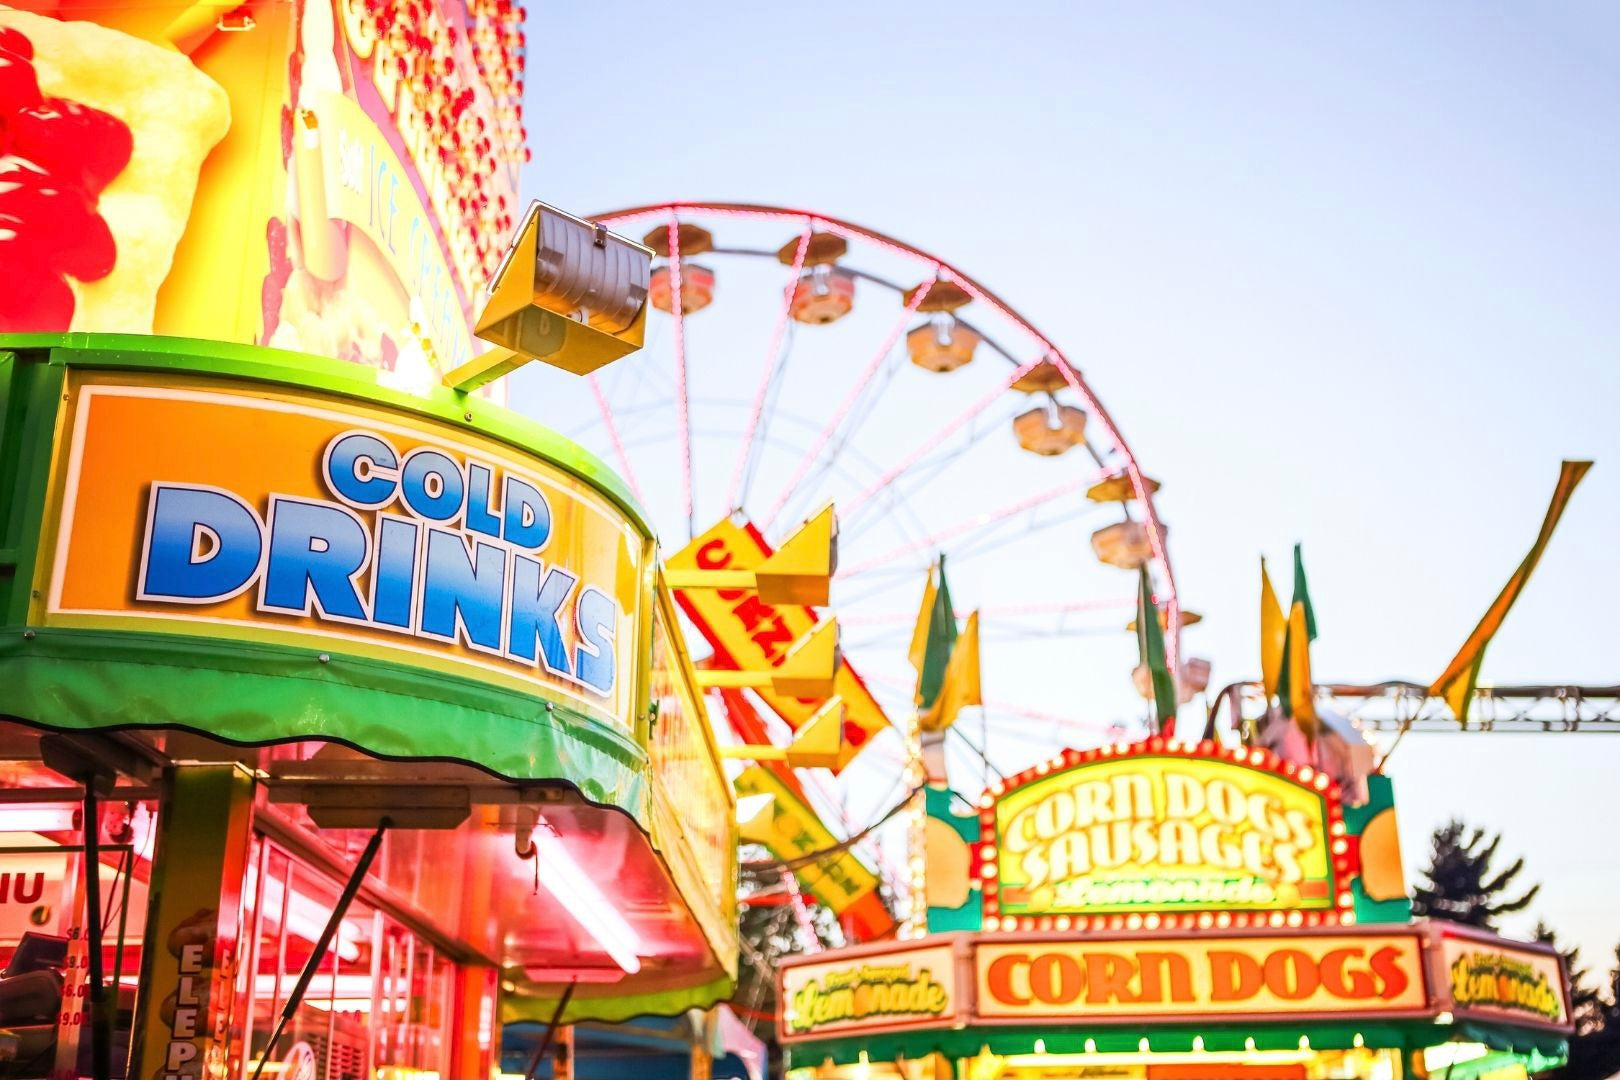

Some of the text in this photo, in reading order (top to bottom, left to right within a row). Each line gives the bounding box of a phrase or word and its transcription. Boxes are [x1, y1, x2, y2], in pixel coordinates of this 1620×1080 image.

[323, 429, 555, 555] COLD
[136, 480, 618, 699] DRINKS
[1003, 771, 1315, 853] CORN DOGS
[1020, 818, 1303, 892] SAUSAGES
[164, 943, 204, 1080] ELEP
[792, 968, 947, 1030] Lemonade
[988, 951, 1196, 1006] CORN
[1207, 946, 1409, 1001] DOGS
